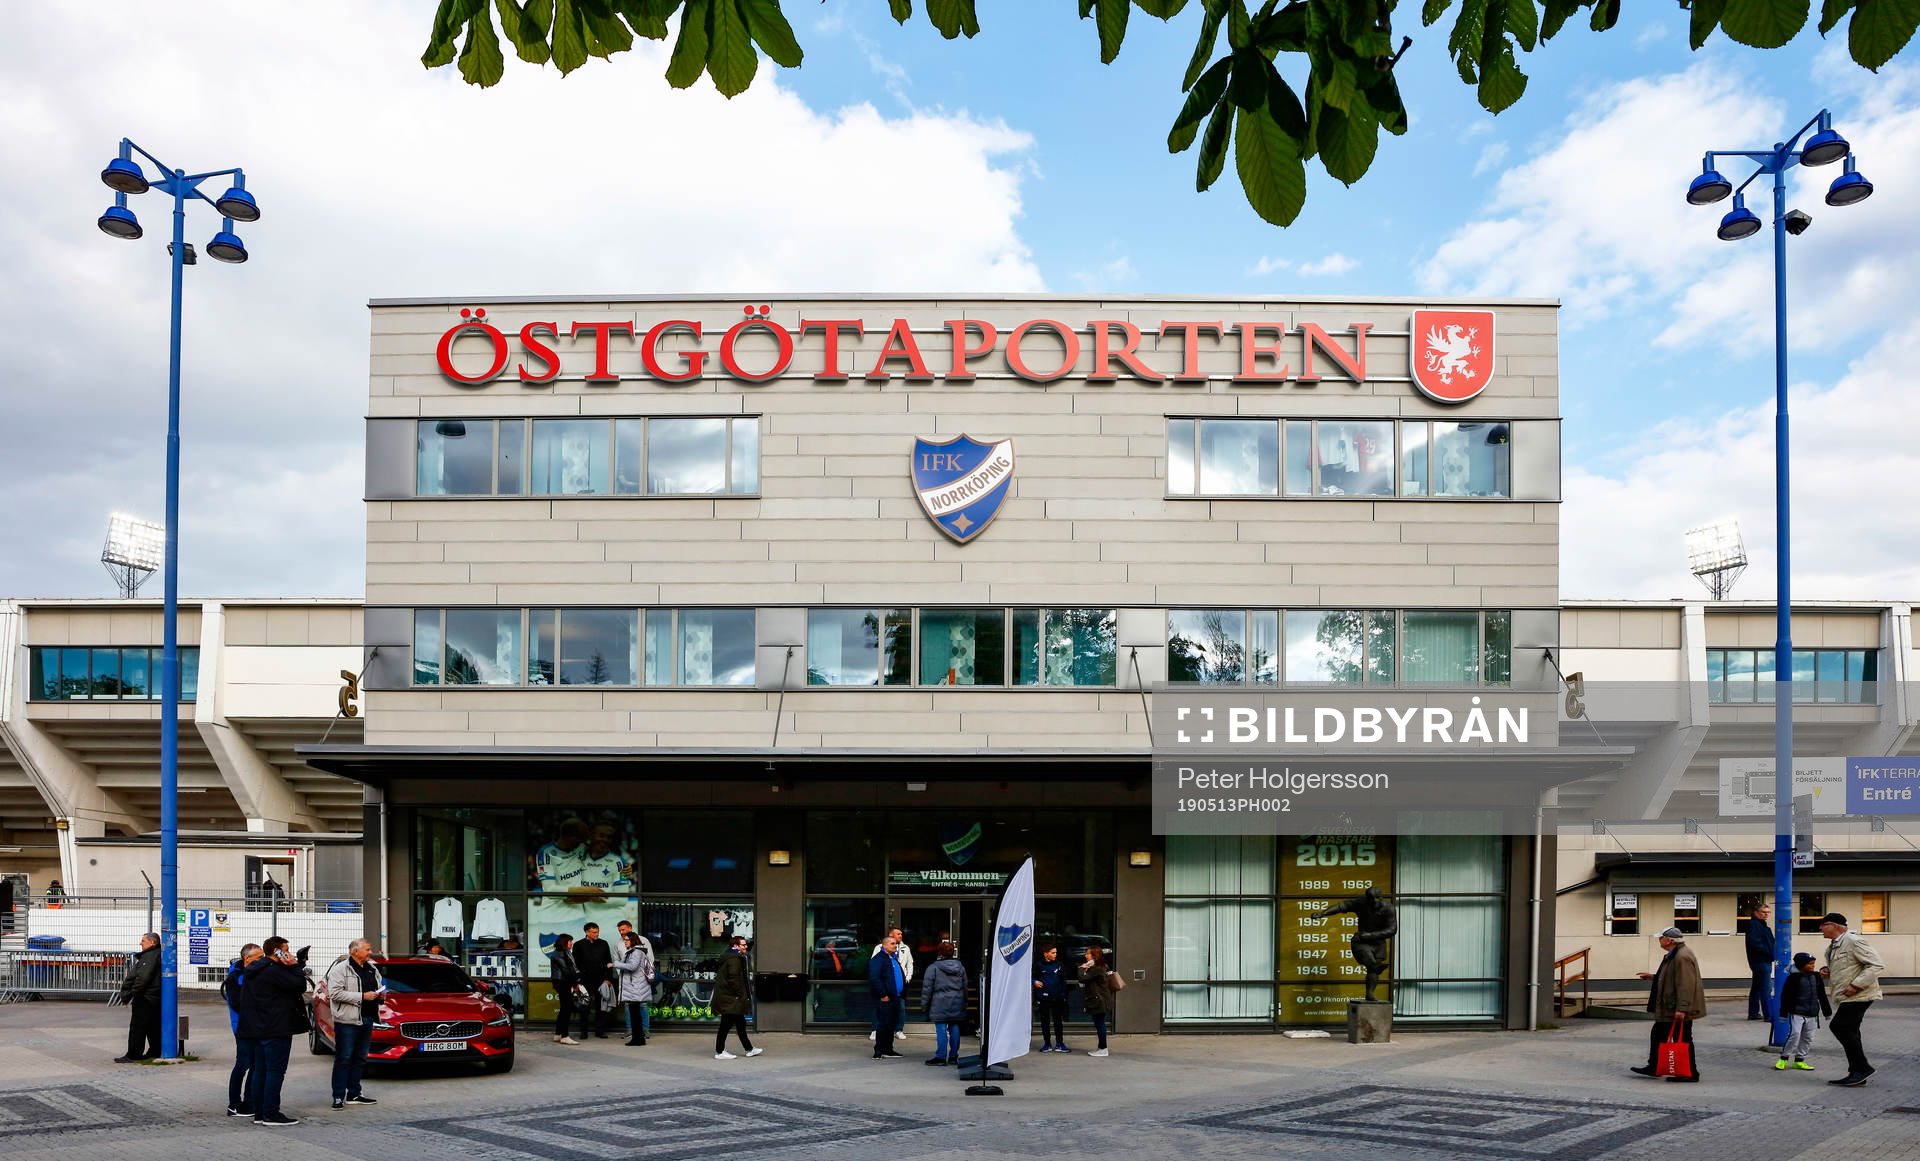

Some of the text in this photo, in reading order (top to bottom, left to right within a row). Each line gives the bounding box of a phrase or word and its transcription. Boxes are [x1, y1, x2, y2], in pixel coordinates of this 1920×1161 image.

[436, 305, 1372, 386] ÖSTGÖTAPORTEN
[921, 453, 964, 471] IFK
[930, 456, 1010, 510] NORRKÖPING
[1857, 768, 1880, 779] IFK
[1795, 775, 1843, 783] FÖRSÄLJNING
[1863, 787, 1912, 801] Entré
[1296, 845, 1376, 867] 2015
[920, 870, 1000, 880] Välkommen
[1299, 880, 1373, 889] 1989 1963
[1298, 902, 1329, 910] 1962
[194, 910, 207, 926] P
[1298, 918, 1359, 926] 1957 19
[1298, 934, 1354, 942] 1952 19
[1298, 950, 1353, 958] 1947 19
[1297, 966, 1327, 975] 1945
[427, 1042, 464, 1051] HRG 80M
